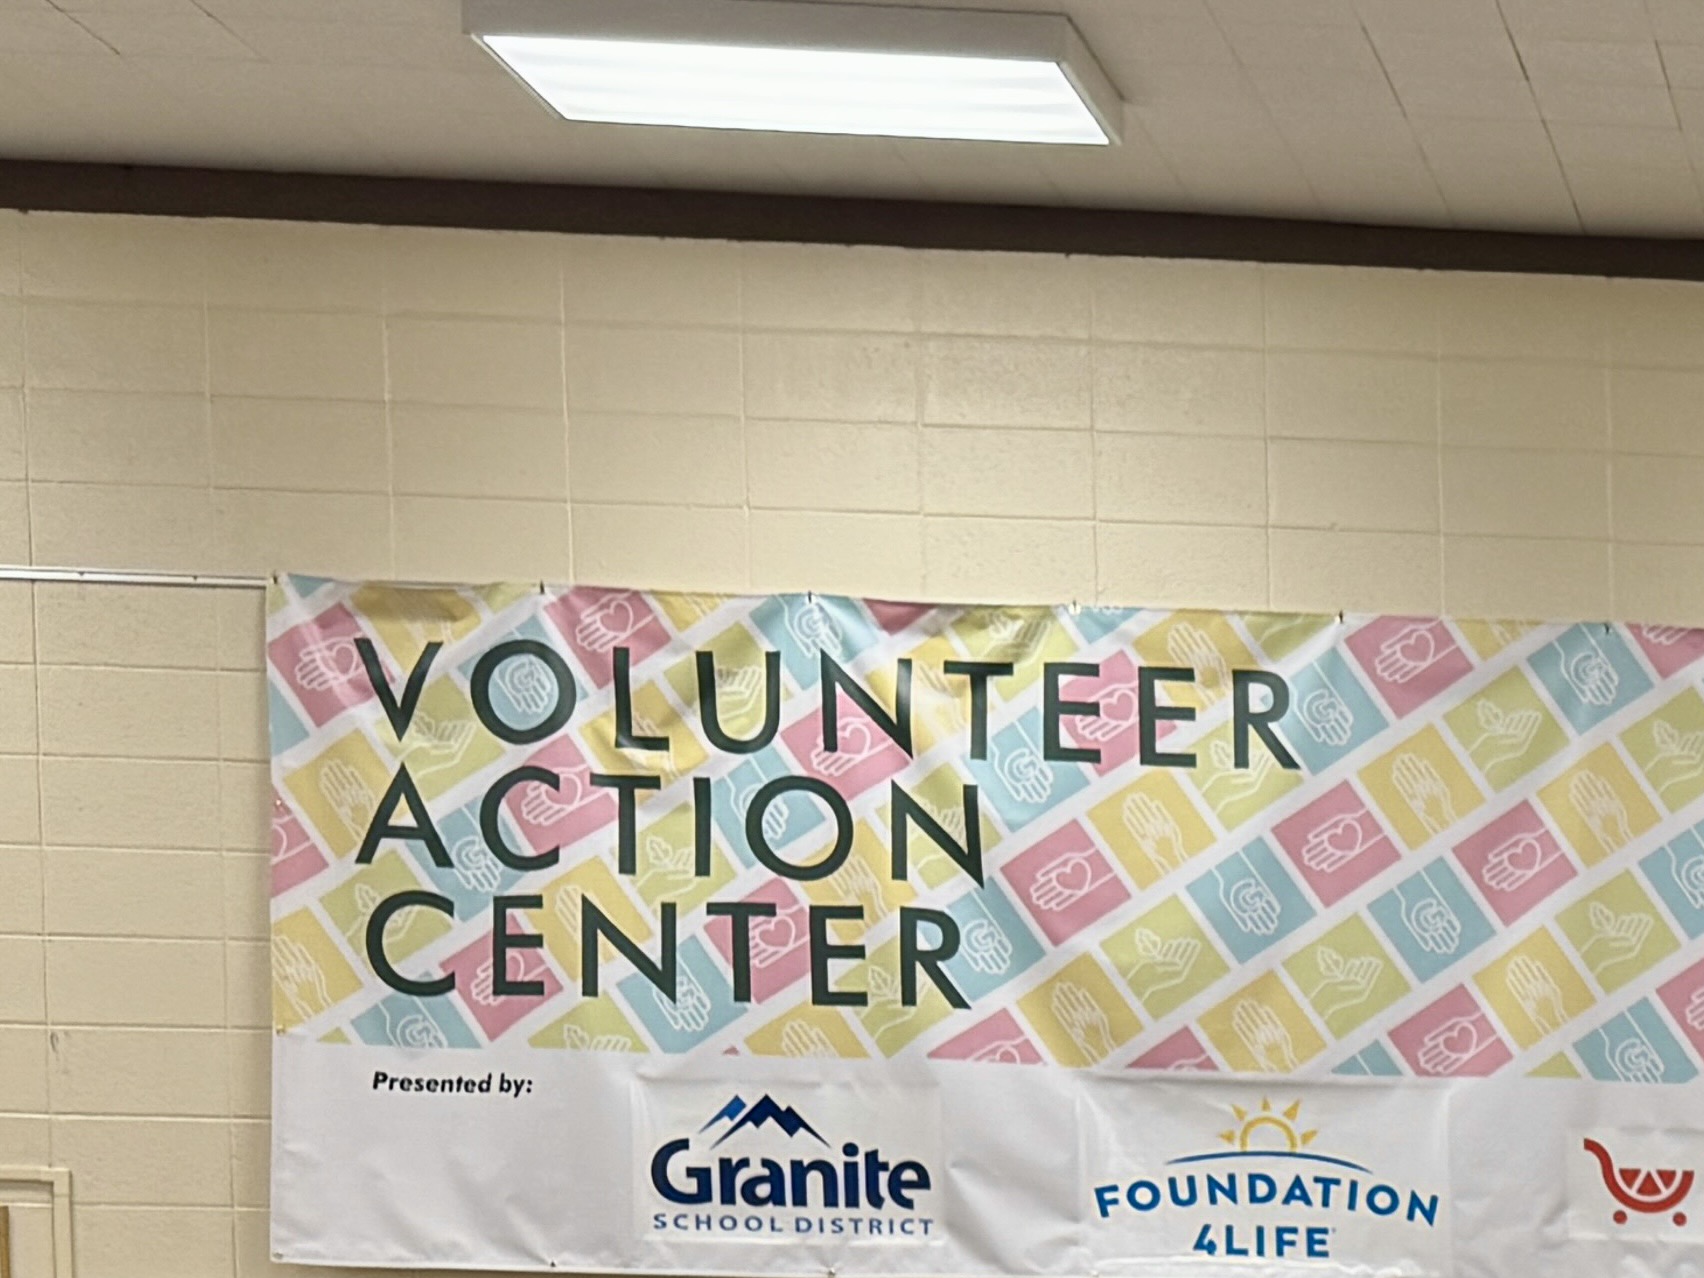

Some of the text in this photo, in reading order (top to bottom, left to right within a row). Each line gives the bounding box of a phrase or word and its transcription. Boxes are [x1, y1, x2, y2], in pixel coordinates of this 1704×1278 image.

[354, 637, 1302, 770] VOLUNTEER
[354, 765, 985, 888] ACTION
[365, 890, 973, 1010] CENTER
[371, 1069, 534, 1098] Presented by:
[651, 1136, 932, 1210] Granite
[1093, 1171, 1439, 1227] FOUNDATION
[652, 1213, 934, 1237] SCHOOL DISTRICT
[1193, 1224, 1333, 1260] 4LIFE
